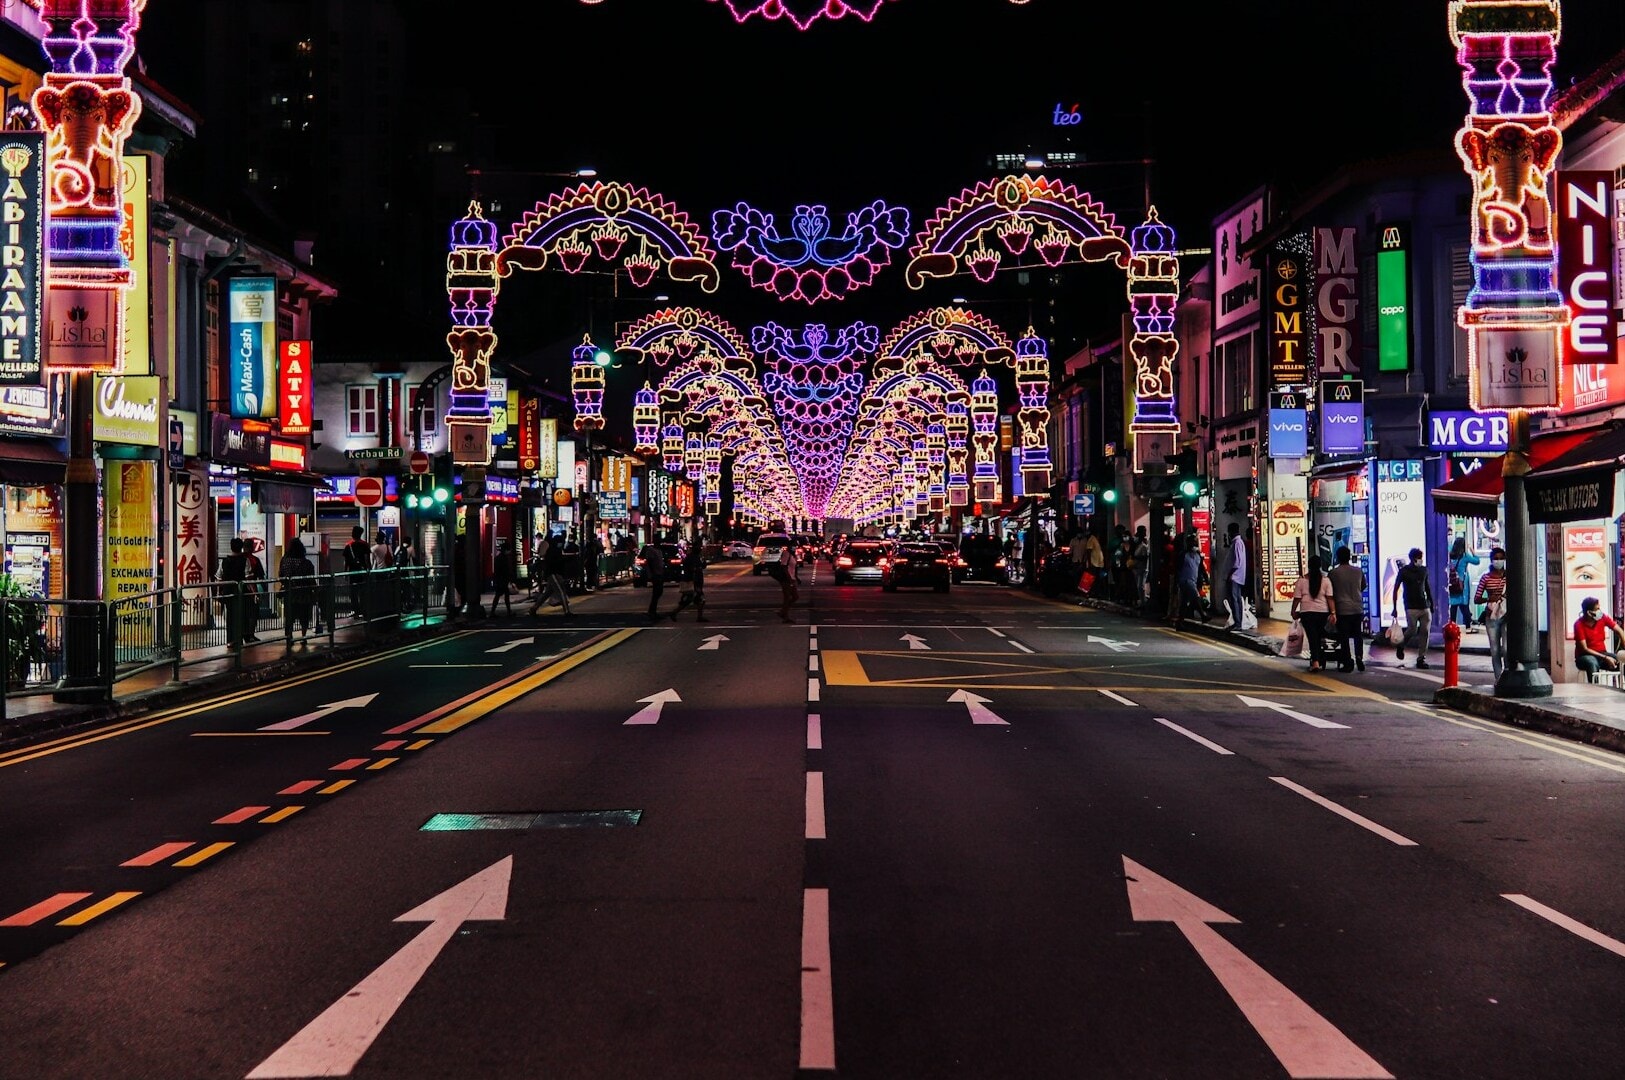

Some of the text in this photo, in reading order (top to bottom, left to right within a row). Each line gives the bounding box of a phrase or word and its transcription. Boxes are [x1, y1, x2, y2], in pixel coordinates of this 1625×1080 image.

[1053, 103, 1081, 125] teó
[1, 177, 27, 360] ABIRAME
[1567, 181, 1608, 353] NICE
[1317, 227, 1360, 374] MGR
[1380, 305, 1405, 316] oppo
[1274, 283, 1303, 363] GMT
[240, 328, 253, 392] Maxi-Cash
[1487, 361, 1547, 383] Lisha
[287, 342, 303, 426] SATYA
[100, 375, 157, 422] Chennai
[1327, 413, 1359, 424] vivo
[1272, 422, 1303, 432] vivo
[1431, 417, 1509, 446] MGR
[349, 448, 400, 458] Kerbau Rd
[1378, 462, 1422, 476] MGR
[1380, 491, 1408, 502] OPPO
[1554, 487, 1568, 512] LUX
[1569, 482, 1600, 510] MOTORS
[1381, 504, 1398, 513] A94
[1319, 524, 1335, 537] 5G
[108, 536, 121, 546] Old
[123, 536, 141, 546] Gold
[1567, 532, 1604, 545] NICE
[111, 568, 154, 578] EXCHANGE
[117, 583, 148, 593] REPAIR
